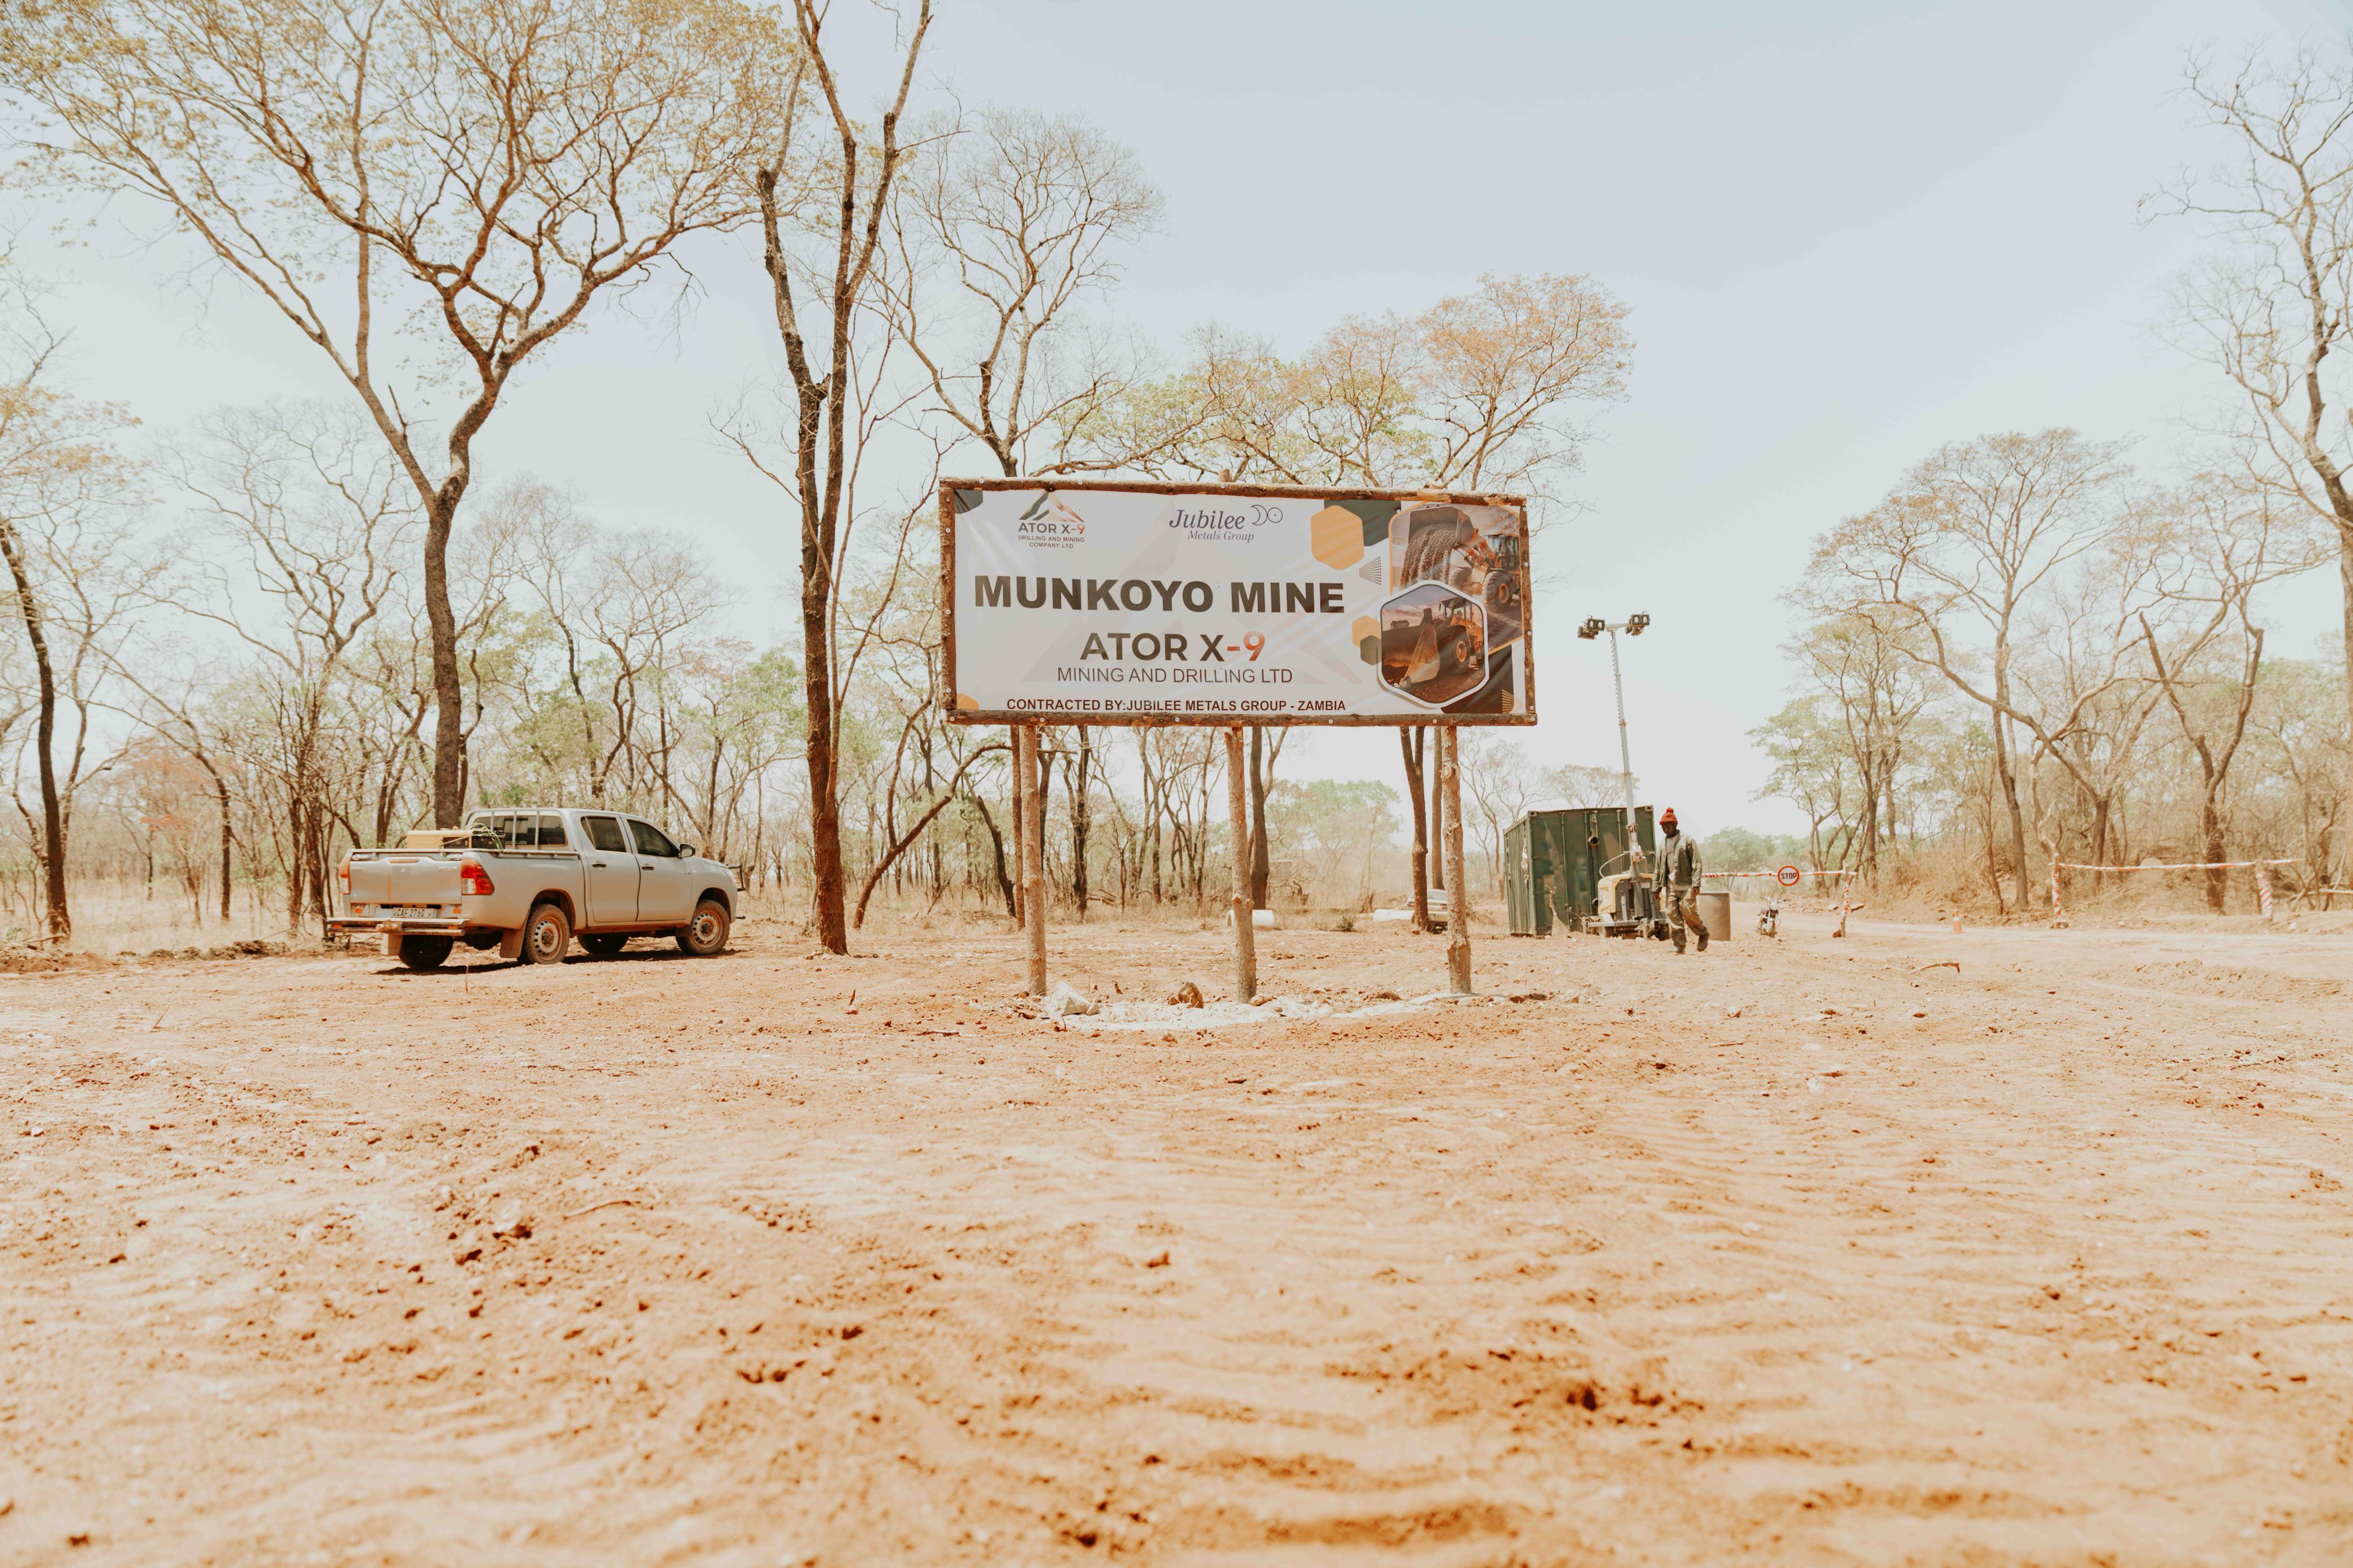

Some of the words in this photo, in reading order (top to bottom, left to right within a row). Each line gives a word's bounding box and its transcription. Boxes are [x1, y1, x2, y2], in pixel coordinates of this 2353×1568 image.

[1169, 509, 1245, 529] Jubilee
[1018, 522, 1057, 533] ATOR
[1061, 524, 1085, 534] X-9
[1188, 530, 1221, 540] Metals
[1223, 531, 1254, 543] Group
[975, 575, 1213, 612] MUNKOYO
[1231, 582, 1344, 614] MINE
[1080, 632, 1188, 661] ATOR
[1200, 630, 1265, 662] X-9
[1057, 667, 1124, 683] MINING
[1128, 668, 1167, 683] AND
[1173, 668, 1255, 683] DRILLING
[1261, 669, 1292, 683] LTD
[1007, 699, 1101, 710] CONTRACTED
[1186, 700, 1236, 711] METALS
[1240, 701, 1287, 711] GROUP
[1298, 701, 1346, 711] ZAMBIA
